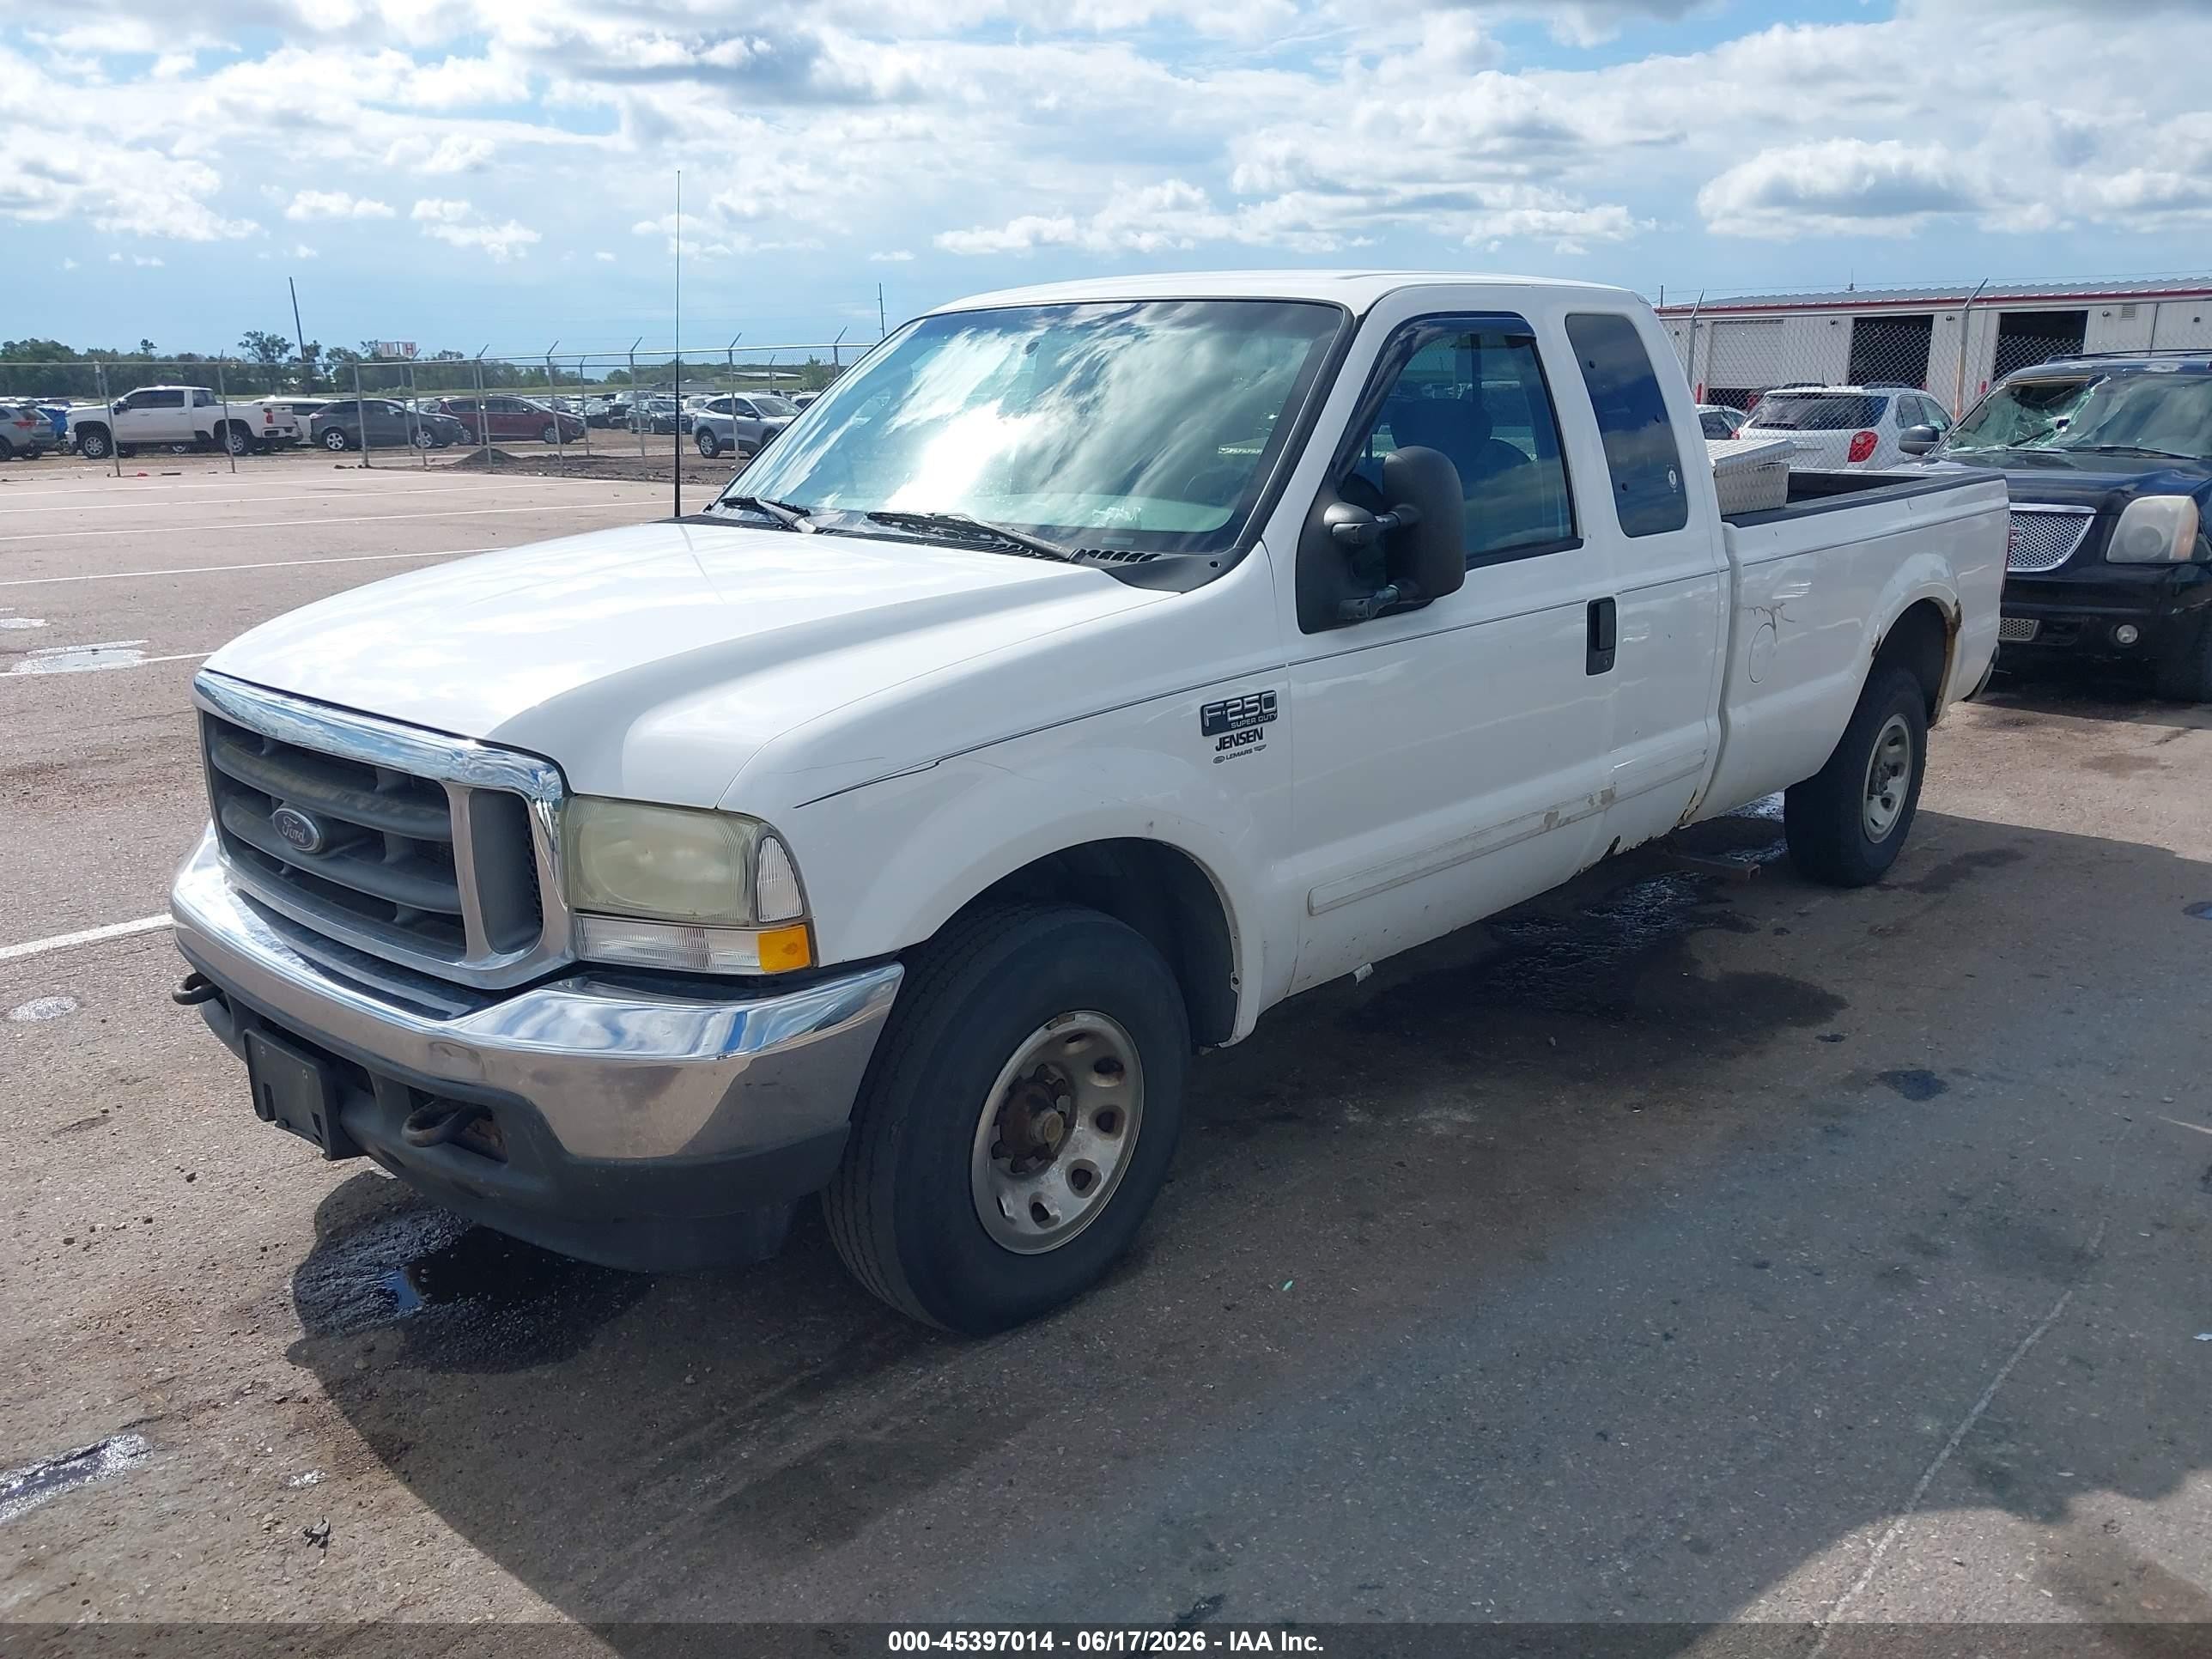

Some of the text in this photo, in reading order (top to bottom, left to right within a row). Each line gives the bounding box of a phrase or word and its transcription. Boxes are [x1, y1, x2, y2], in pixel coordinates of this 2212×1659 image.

[1231, 713, 1278, 729] SUPER DUTY
[1215, 726, 1264, 751] JENSEN
